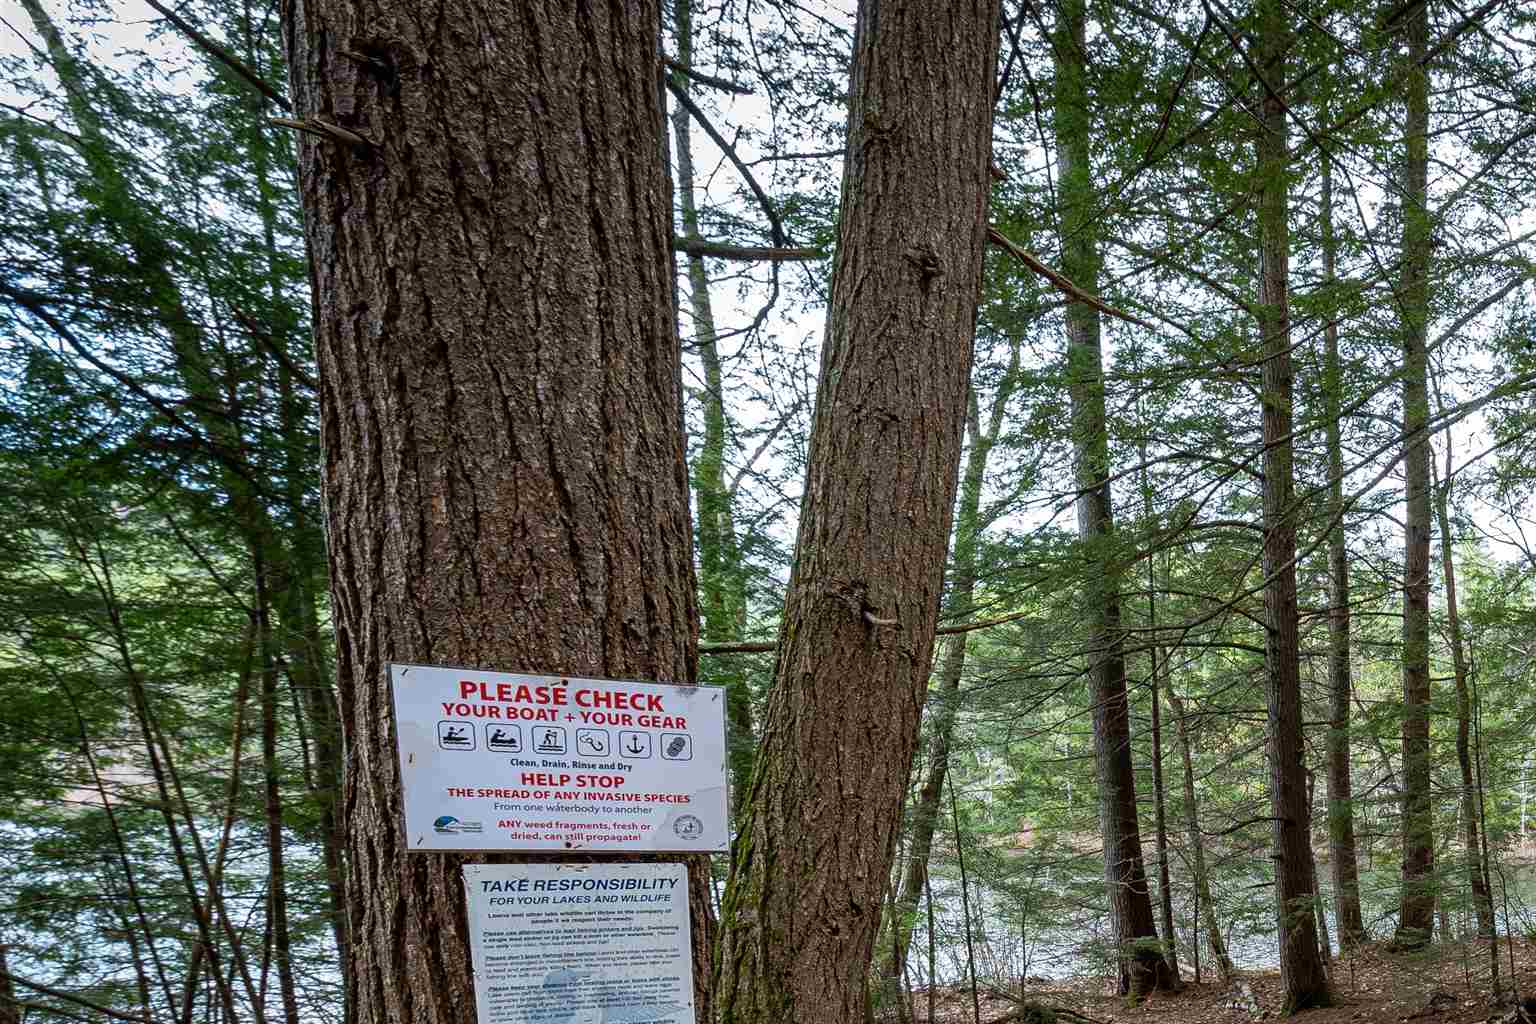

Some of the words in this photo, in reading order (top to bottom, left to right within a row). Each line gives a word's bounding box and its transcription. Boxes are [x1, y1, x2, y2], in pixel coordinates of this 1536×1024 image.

[459, 680, 568, 705] PLEASE
[575, 689, 665, 712] CHECK
[442, 702, 501, 719] YOUR
[507, 706, 558, 723] BOAT
[564, 713, 577, 724] +
[580, 711, 632, 727] YOUR
[638, 715, 687, 730] GEAR
[510, 758, 539, 769] Clean,
[541, 759, 570, 770] Drain,
[572, 760, 596, 769] Rinse
[598, 761, 616, 770] and
[617, 762, 633, 772] Dry
[521, 773, 571, 787] HELP
[576, 775, 625, 788] STOP
[447, 787, 476, 798] THE
[477, 789, 529, 799] SPREAD
[533, 790, 551, 800] OF
[554, 791, 581, 801] ANY
[583, 792, 642, 802] INVASIVE
[644, 793, 691, 804] SPECIES
[494, 802, 521, 812] From
[523, 804, 544, 813] one
[546, 803, 600, 815] waterbody
[602, 805, 613, 814] to
[614, 805, 653, 815] another
[497, 819, 522, 829] ANY
[524, 820, 553, 830] weed
[554, 821, 610, 833] fragments,
[612, 821, 639, 831] fresh
[510, 830, 542, 842] dried,
[544, 833, 562, 841] can
[564, 832, 584, 841] still
[586, 832, 641, 843] propagate!
[481, 879, 529, 893] TAKE
[533, 878, 679, 892] RESPONSIBILITY
[489, 896, 515, 905] FOR
[517, 896, 550, 905] YOUR
[552, 895, 591, 904] LAKES
[594, 894, 618, 903] AND
[620, 894, 671, 903] WILDLIFE
